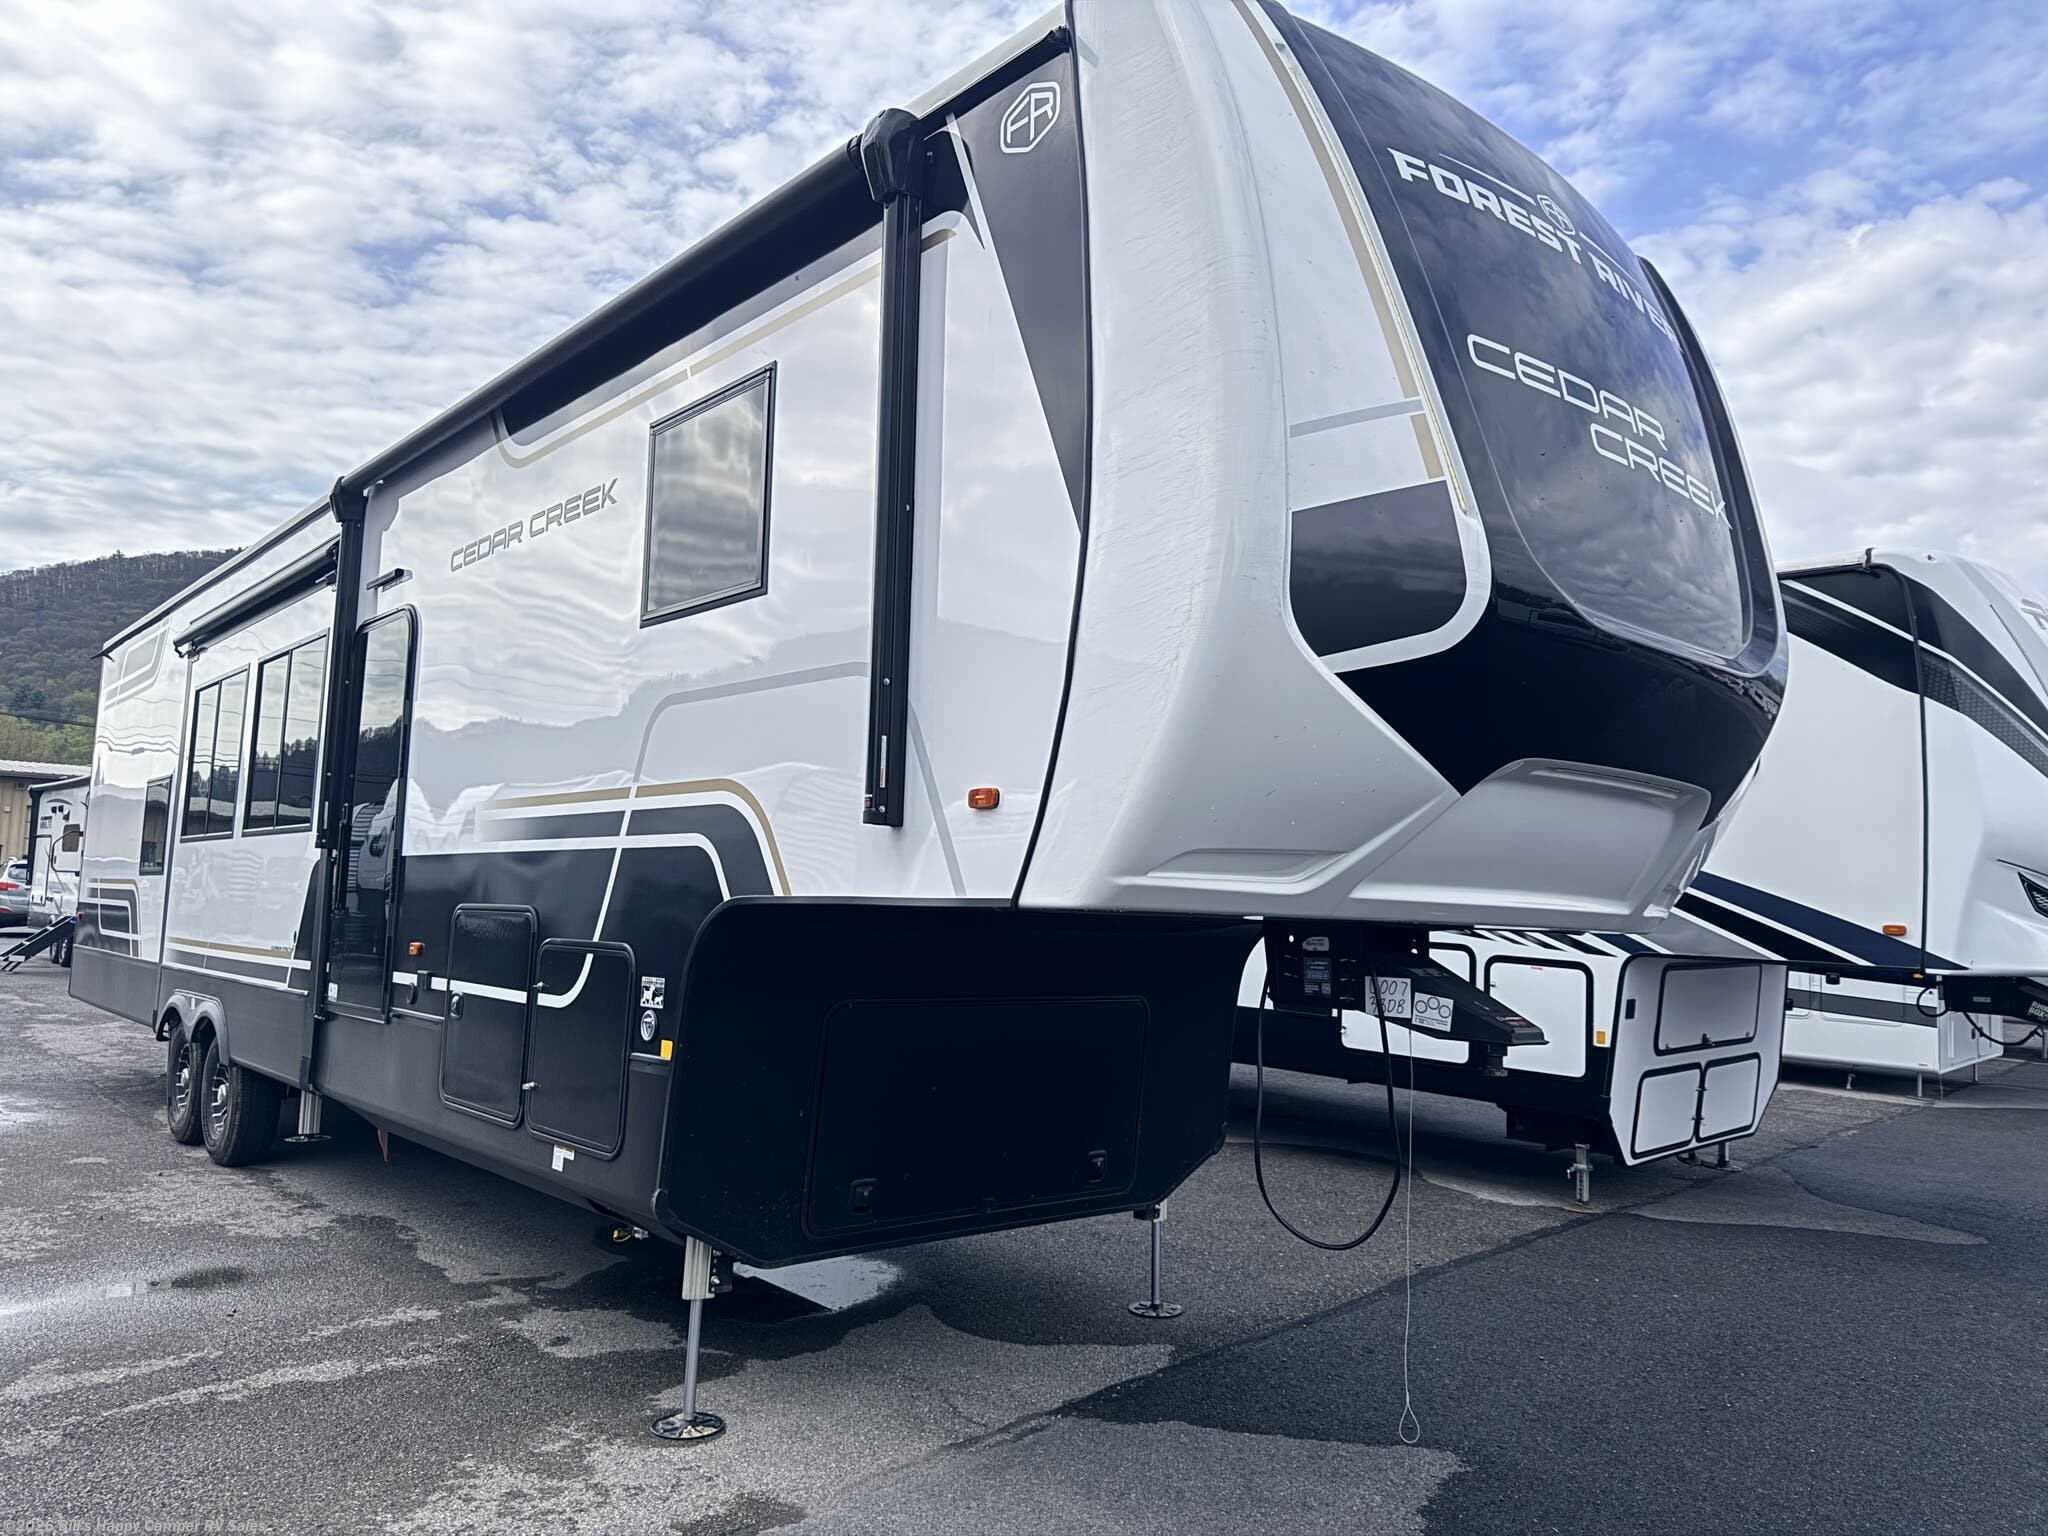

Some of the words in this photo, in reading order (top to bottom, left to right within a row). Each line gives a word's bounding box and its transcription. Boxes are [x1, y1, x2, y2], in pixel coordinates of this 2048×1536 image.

[1387, 147, 1582, 264] FOREST
[1588, 251, 1684, 353] RIVER
[1467, 333, 1669, 451] CEDAR
[450, 520, 524, 573] CEDAR
[529, 477, 618, 538] CREEK
[1590, 422, 1732, 529] CREEK
